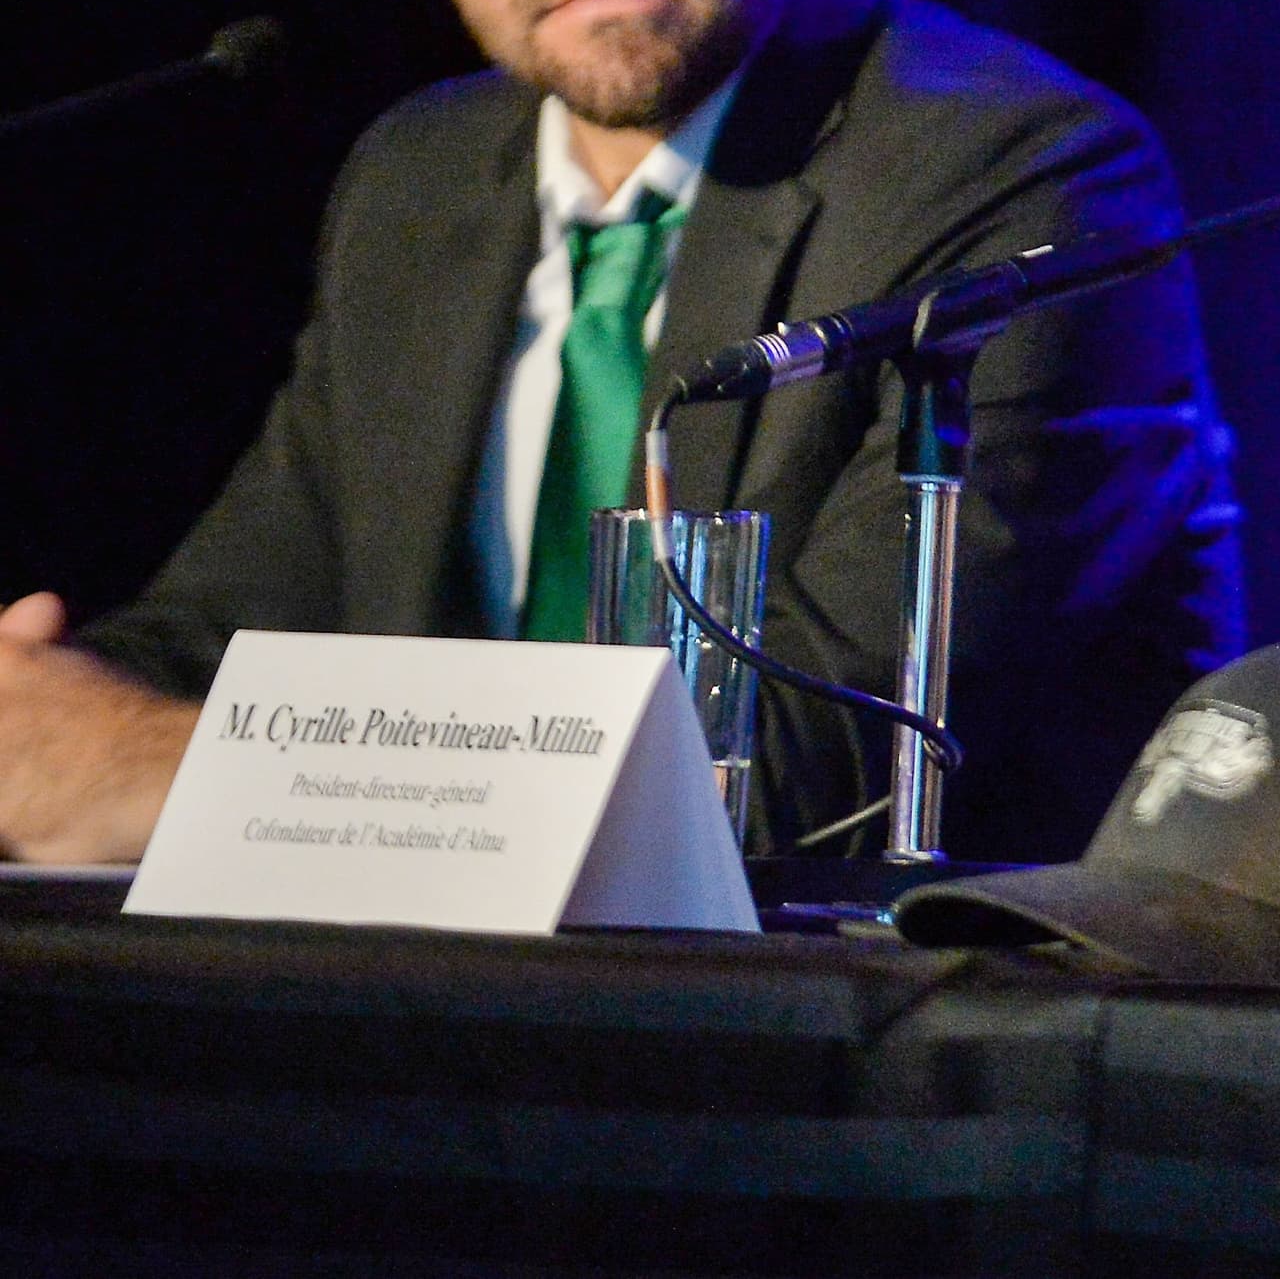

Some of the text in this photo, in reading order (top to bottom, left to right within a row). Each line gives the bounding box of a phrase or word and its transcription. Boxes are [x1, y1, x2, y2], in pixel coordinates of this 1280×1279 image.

[217, 702, 606, 756] M. Cyrille Poitevineau-Millin
[287, 772, 492, 809] Président-directeur-général
[243, 816, 338, 846] Cofondateur
[337, 821, 358, 846] de
